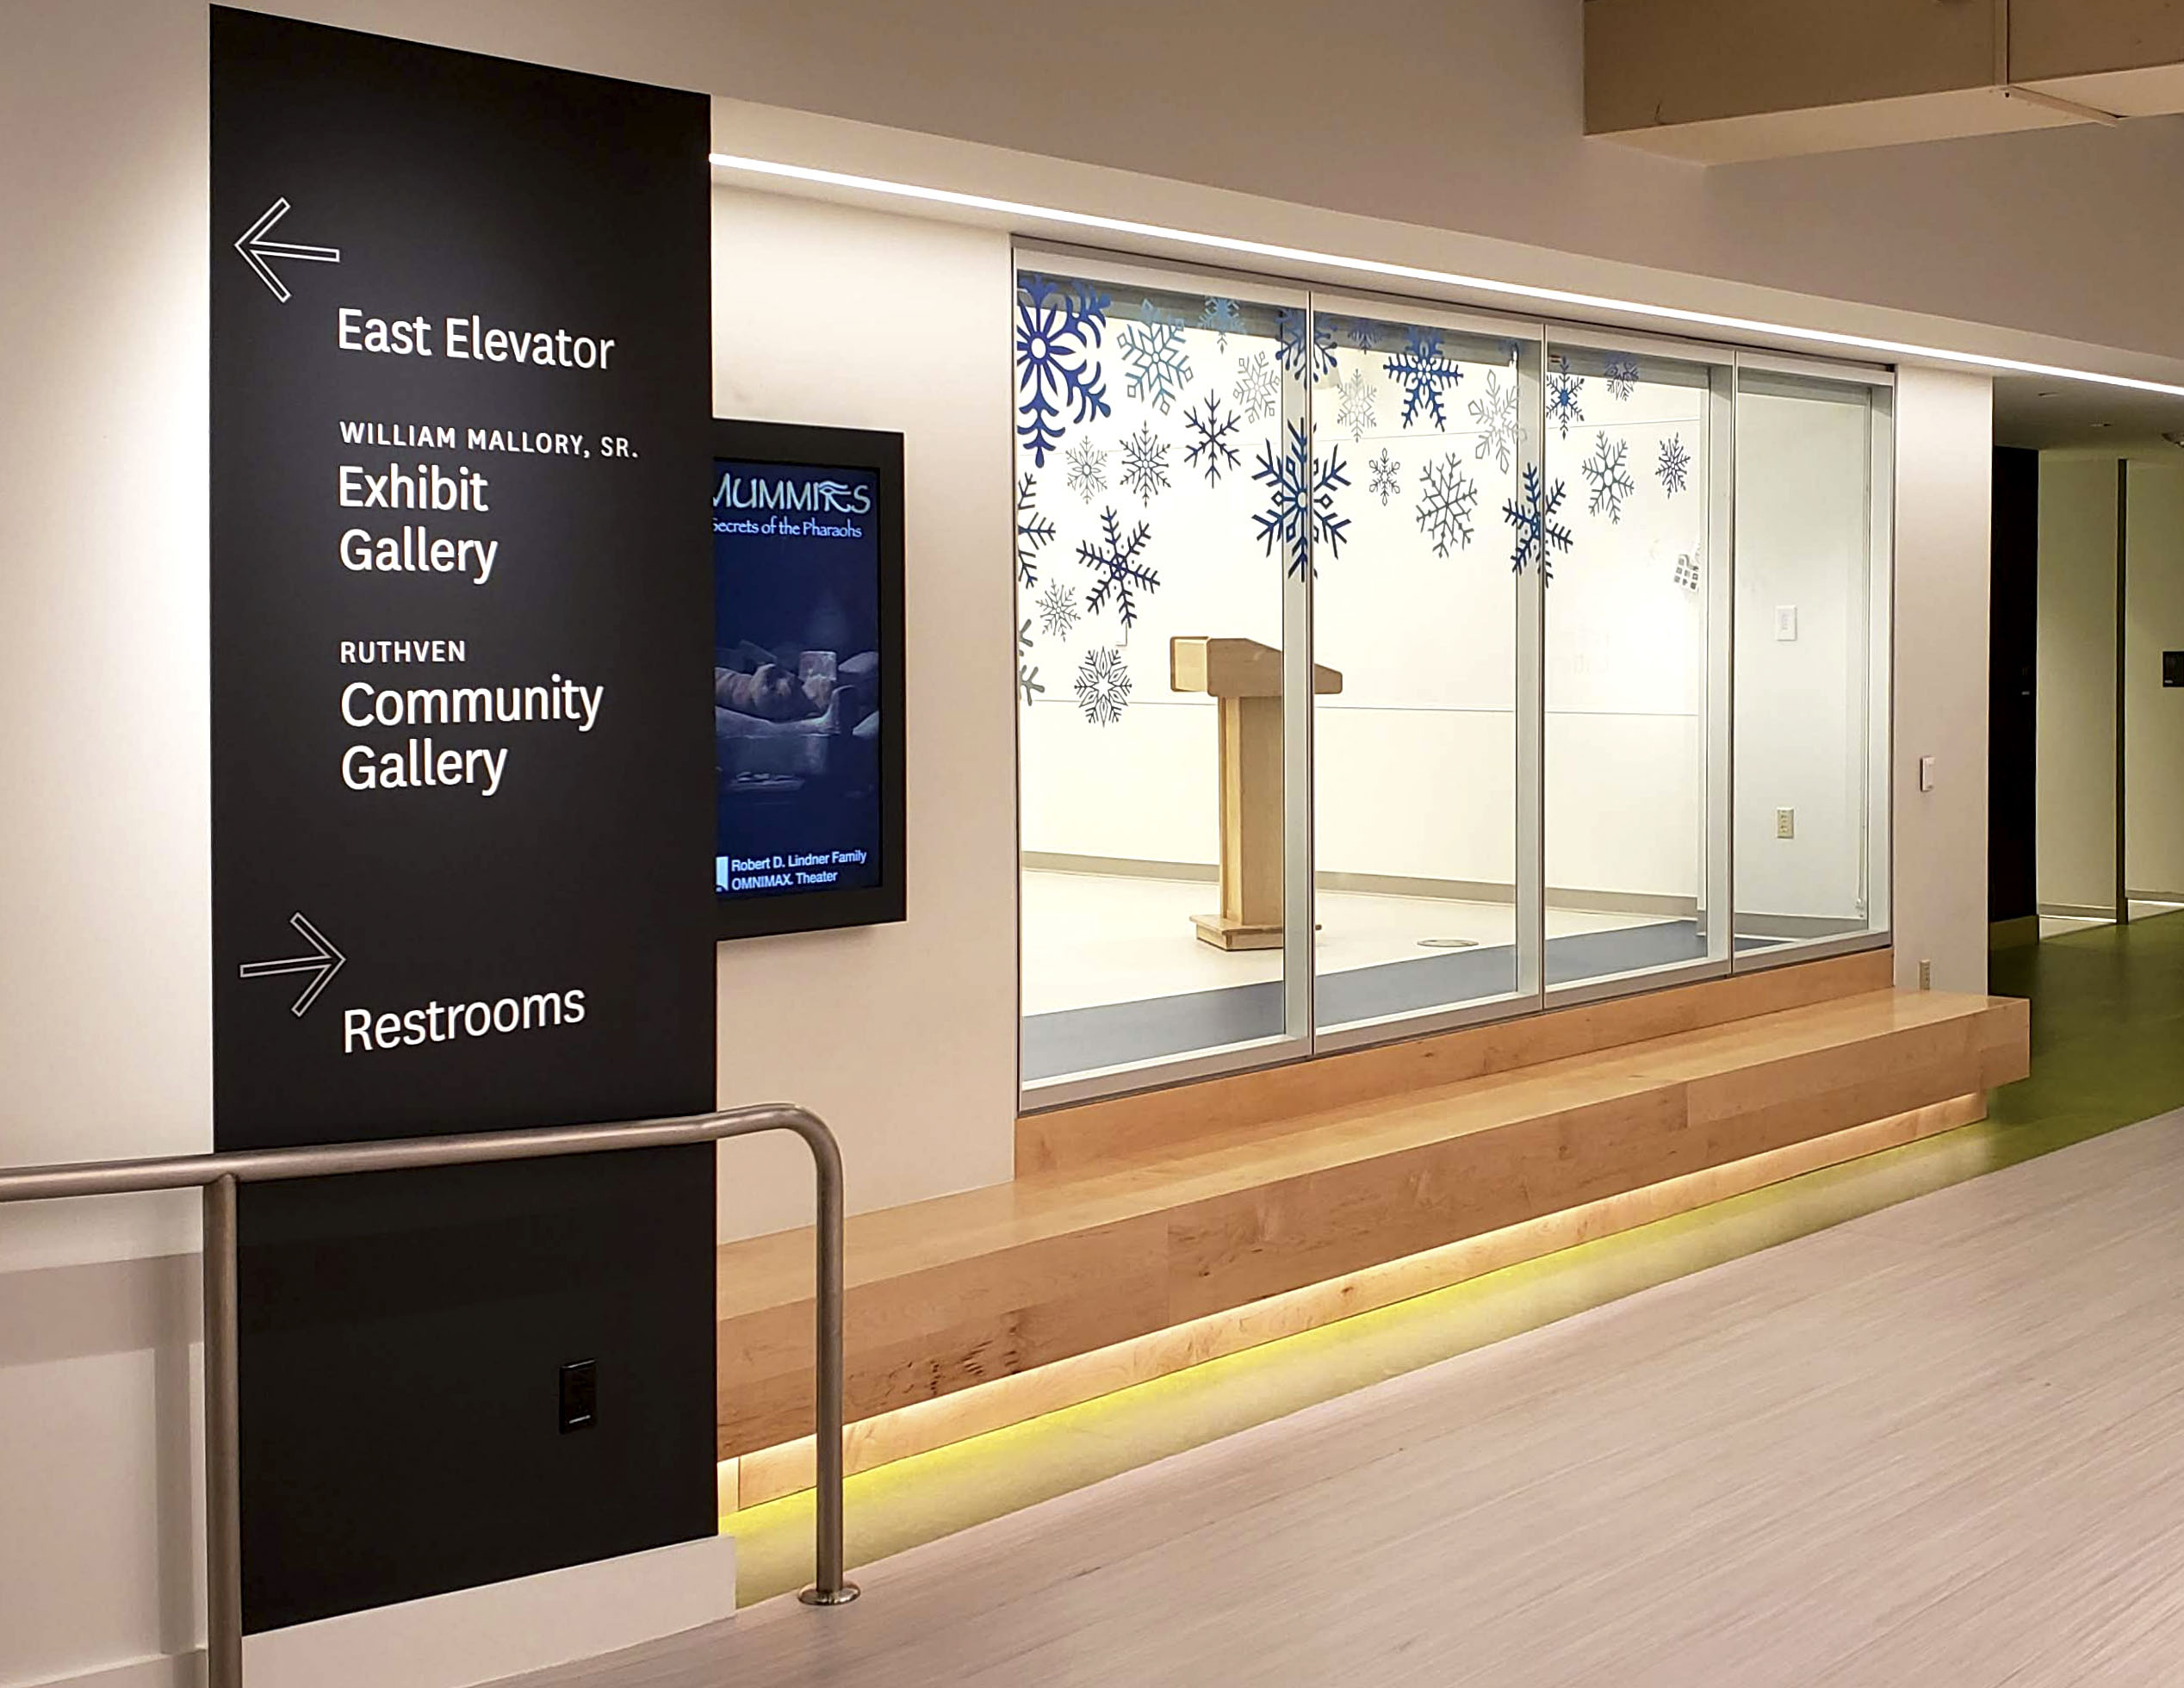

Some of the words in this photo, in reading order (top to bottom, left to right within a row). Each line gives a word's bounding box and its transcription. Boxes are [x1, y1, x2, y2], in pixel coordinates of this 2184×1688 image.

[338, 307, 433, 357] East
[446, 314, 616, 369] Elevator
[339, 420, 456, 449] WILLIAM
[468, 428, 590, 459] MALLORY,
[600, 436, 638, 458] SR.
[339, 462, 489, 512] Exhibit
[761, 515, 778, 535] of
[779, 516, 801, 536] the
[803, 517, 862, 538] Pharaohs
[339, 525, 499, 585] Gallery
[340, 640, 466, 664] RUTHVEN
[341, 673, 605, 732] Community
[342, 737, 508, 797] Gallery
[731, 858, 771, 872] Robert
[772, 855, 785, 869] D.
[788, 853, 830, 867] Lindner
[831, 849, 867, 864] Family
[795, 871, 839, 884] Theater
[344, 990, 585, 1053] Restrooms
